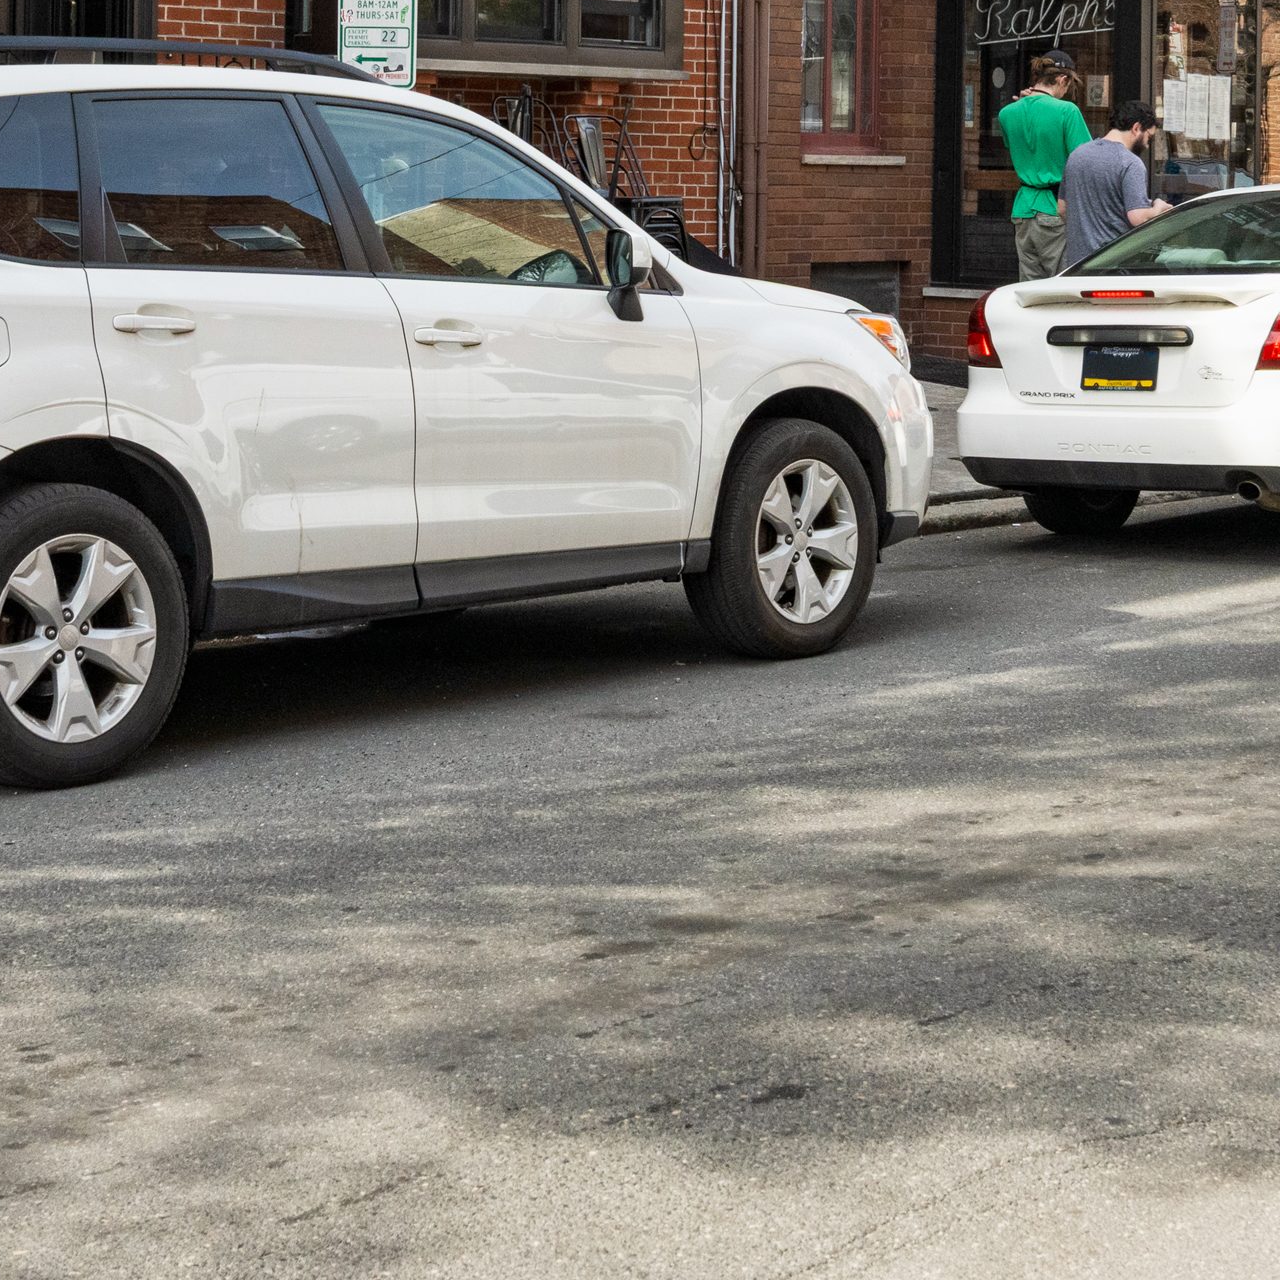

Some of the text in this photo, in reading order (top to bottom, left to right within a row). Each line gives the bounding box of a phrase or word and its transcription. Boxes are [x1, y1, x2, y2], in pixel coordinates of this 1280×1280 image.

[357, 0, 398, 8] 8AM-12AM
[356, 11, 399, 19] THURS-SAT
[382, 30, 397, 42] 22
[1057, 442, 1152, 456] PONTIAC
